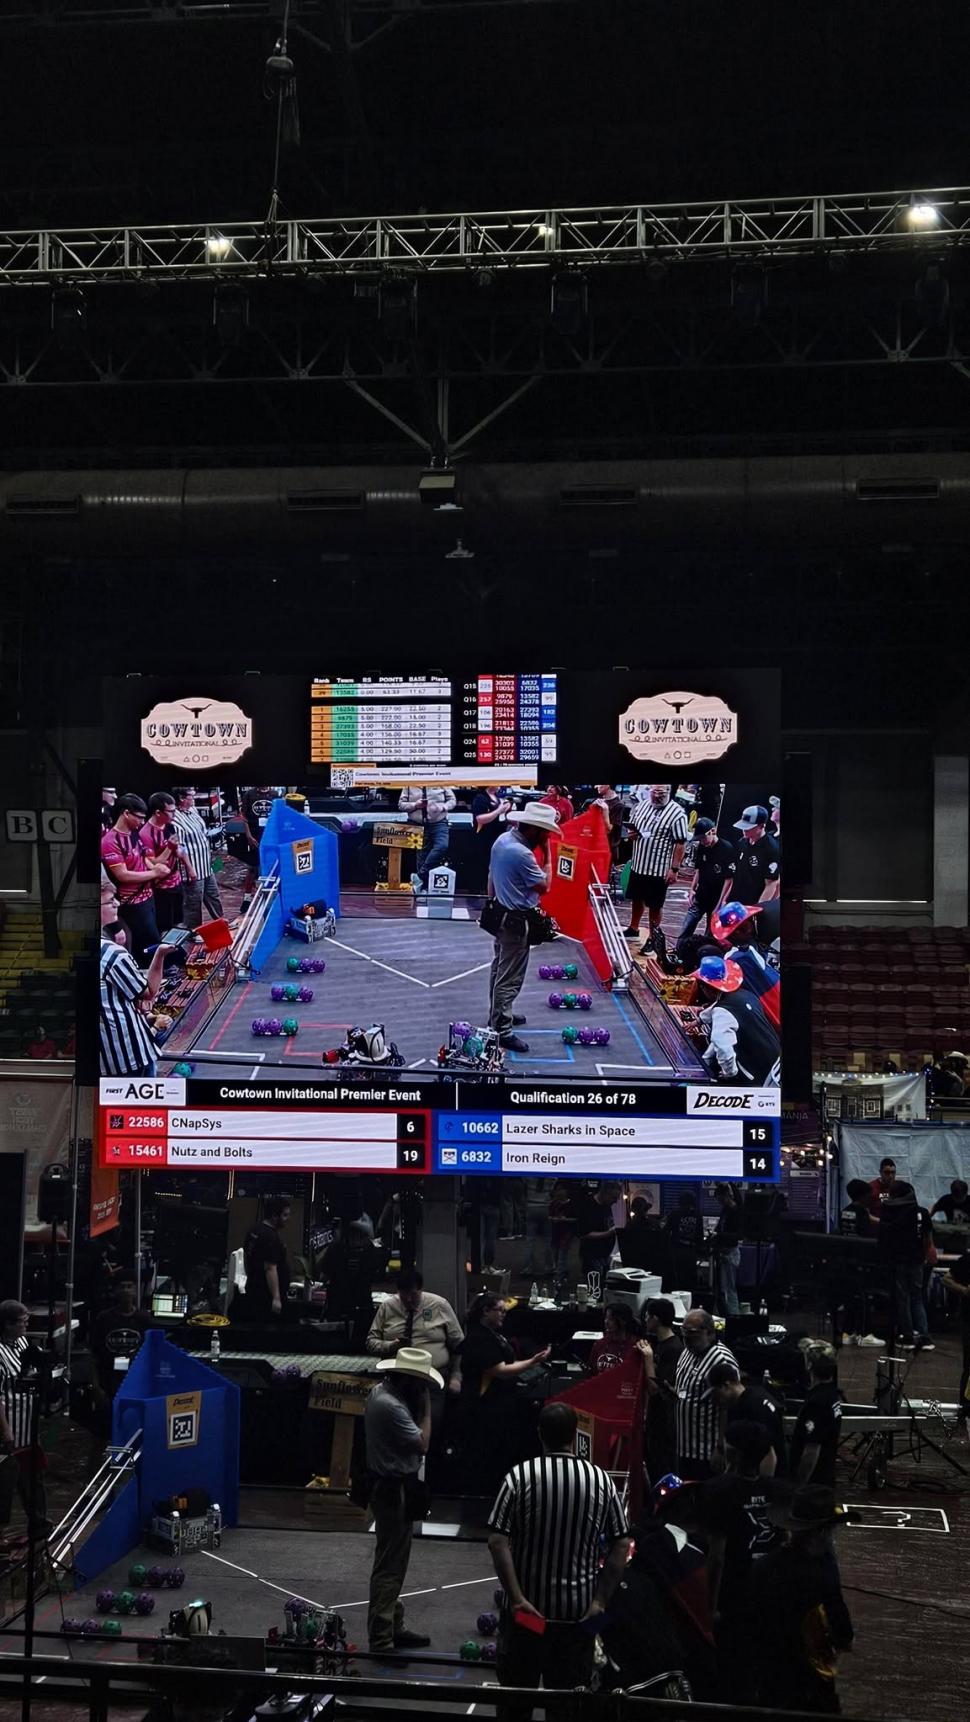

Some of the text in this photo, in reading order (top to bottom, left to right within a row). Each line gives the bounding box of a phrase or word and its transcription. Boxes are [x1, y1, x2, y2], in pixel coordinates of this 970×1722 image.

[147, 723, 247, 738] COWTOWN
[625, 718, 732, 734] COWTOWN
[10, 816, 33, 834] B
[48, 816, 67, 834] C
[220, 1087, 421, 1101] Cowtown Invitational Premier Event
[510, 1092, 636, 1104] Qualification 26 of 78
[694, 1092, 754, 1109] DECODE
[128, 1117, 414, 1132] 22586 CNapSys 6
[462, 1122, 766, 1140] 10662 Lazer Sharks in Space 15
[129, 1145, 418, 1161] 15461 Nutz and Bolts 19
[461, 1151, 766, 1169] 6832 Iron Reign 14
